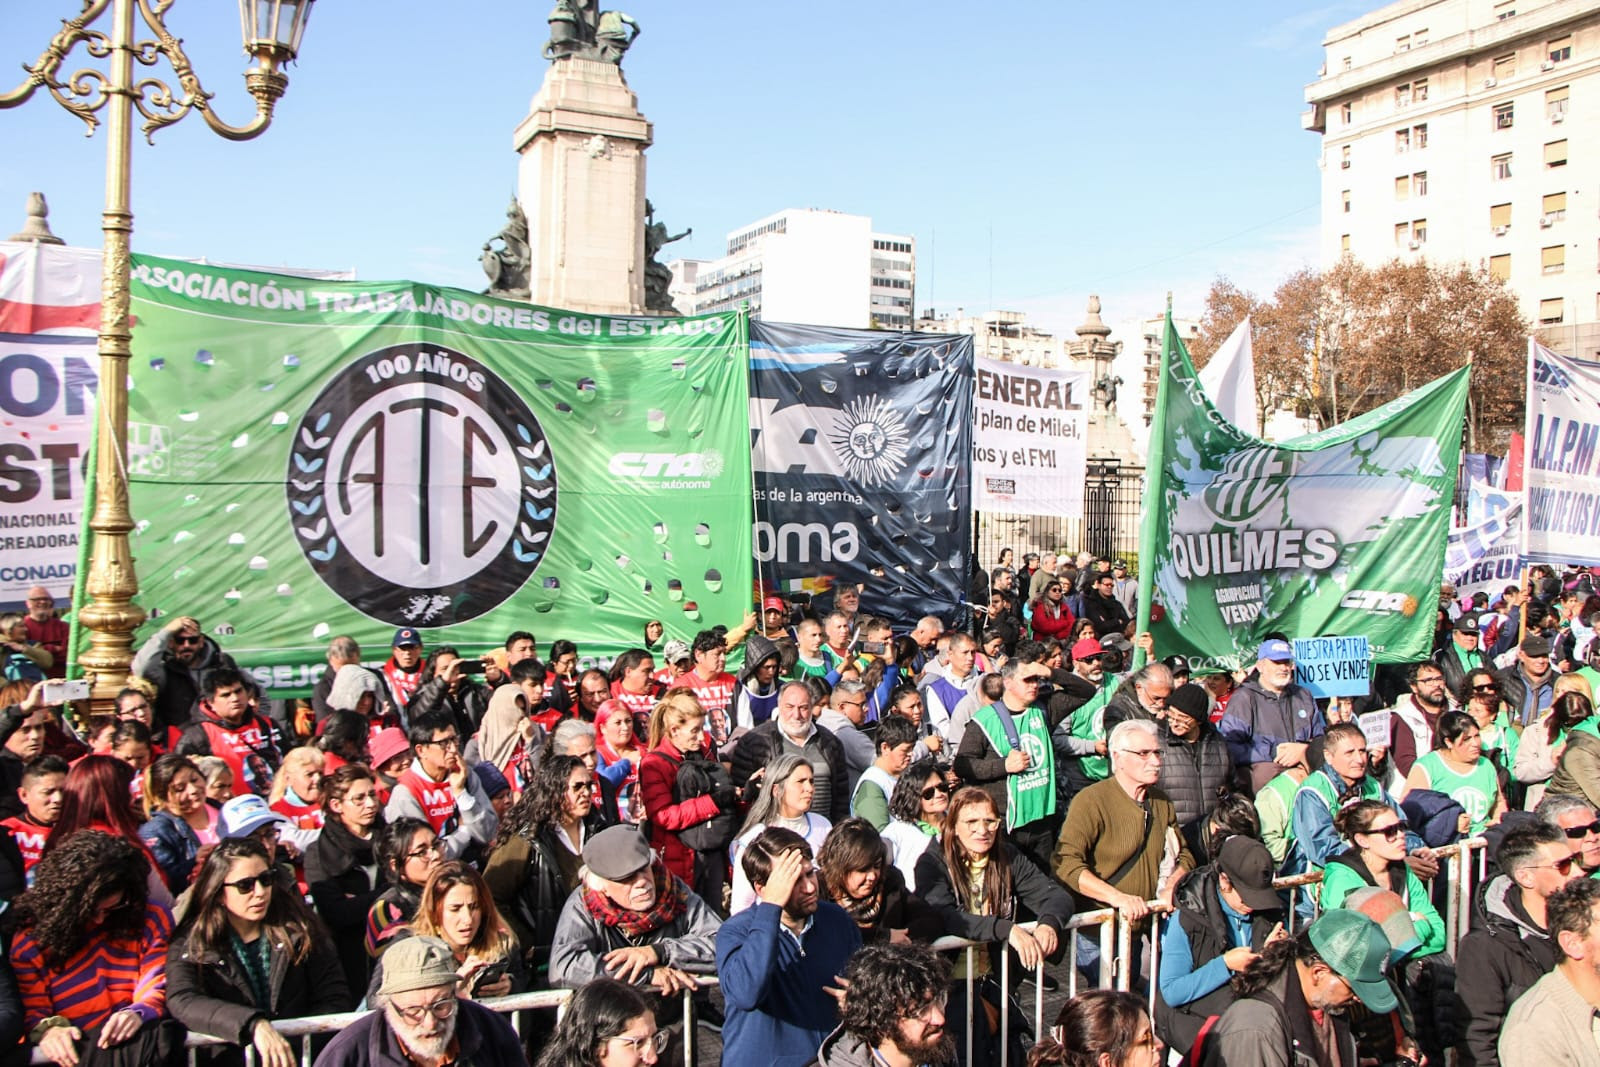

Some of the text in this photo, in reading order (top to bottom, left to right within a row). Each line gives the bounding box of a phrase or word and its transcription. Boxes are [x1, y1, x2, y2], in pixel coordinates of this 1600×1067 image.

[130, 264, 726, 337] ASOCIACIÓN TRABAJADORES del ESTADO
[365, 351, 486, 392] 100 AÑOS
[981, 409, 1012, 432] plan
[1016, 414, 1036, 432] de
[1040, 416, 1080, 440] Milei,
[608, 452, 705, 477] CTA
[999, 448, 1008, 468] y
[1012, 447, 1026, 466] el
[1029, 448, 1056, 468] FMI
[0, 443, 89, 503] ST
[338, 397, 498, 565] ATE
[769, 488, 786, 502] de
[790, 488, 803, 502] la
[0, 512, 76, 529] NACIONAL
[0, 533, 81, 551] CREADORA
[1172, 528, 1337, 581] QUILMES
[1215, 582, 1260, 604] AGRUPACIÓN
[1295, 638, 1335, 660] NUESTRA
[1336, 637, 1367, 660] PATRIA
[1296, 658, 1369, 685] NO SE VENDE!
[1018, 777, 1050, 793] MONED
